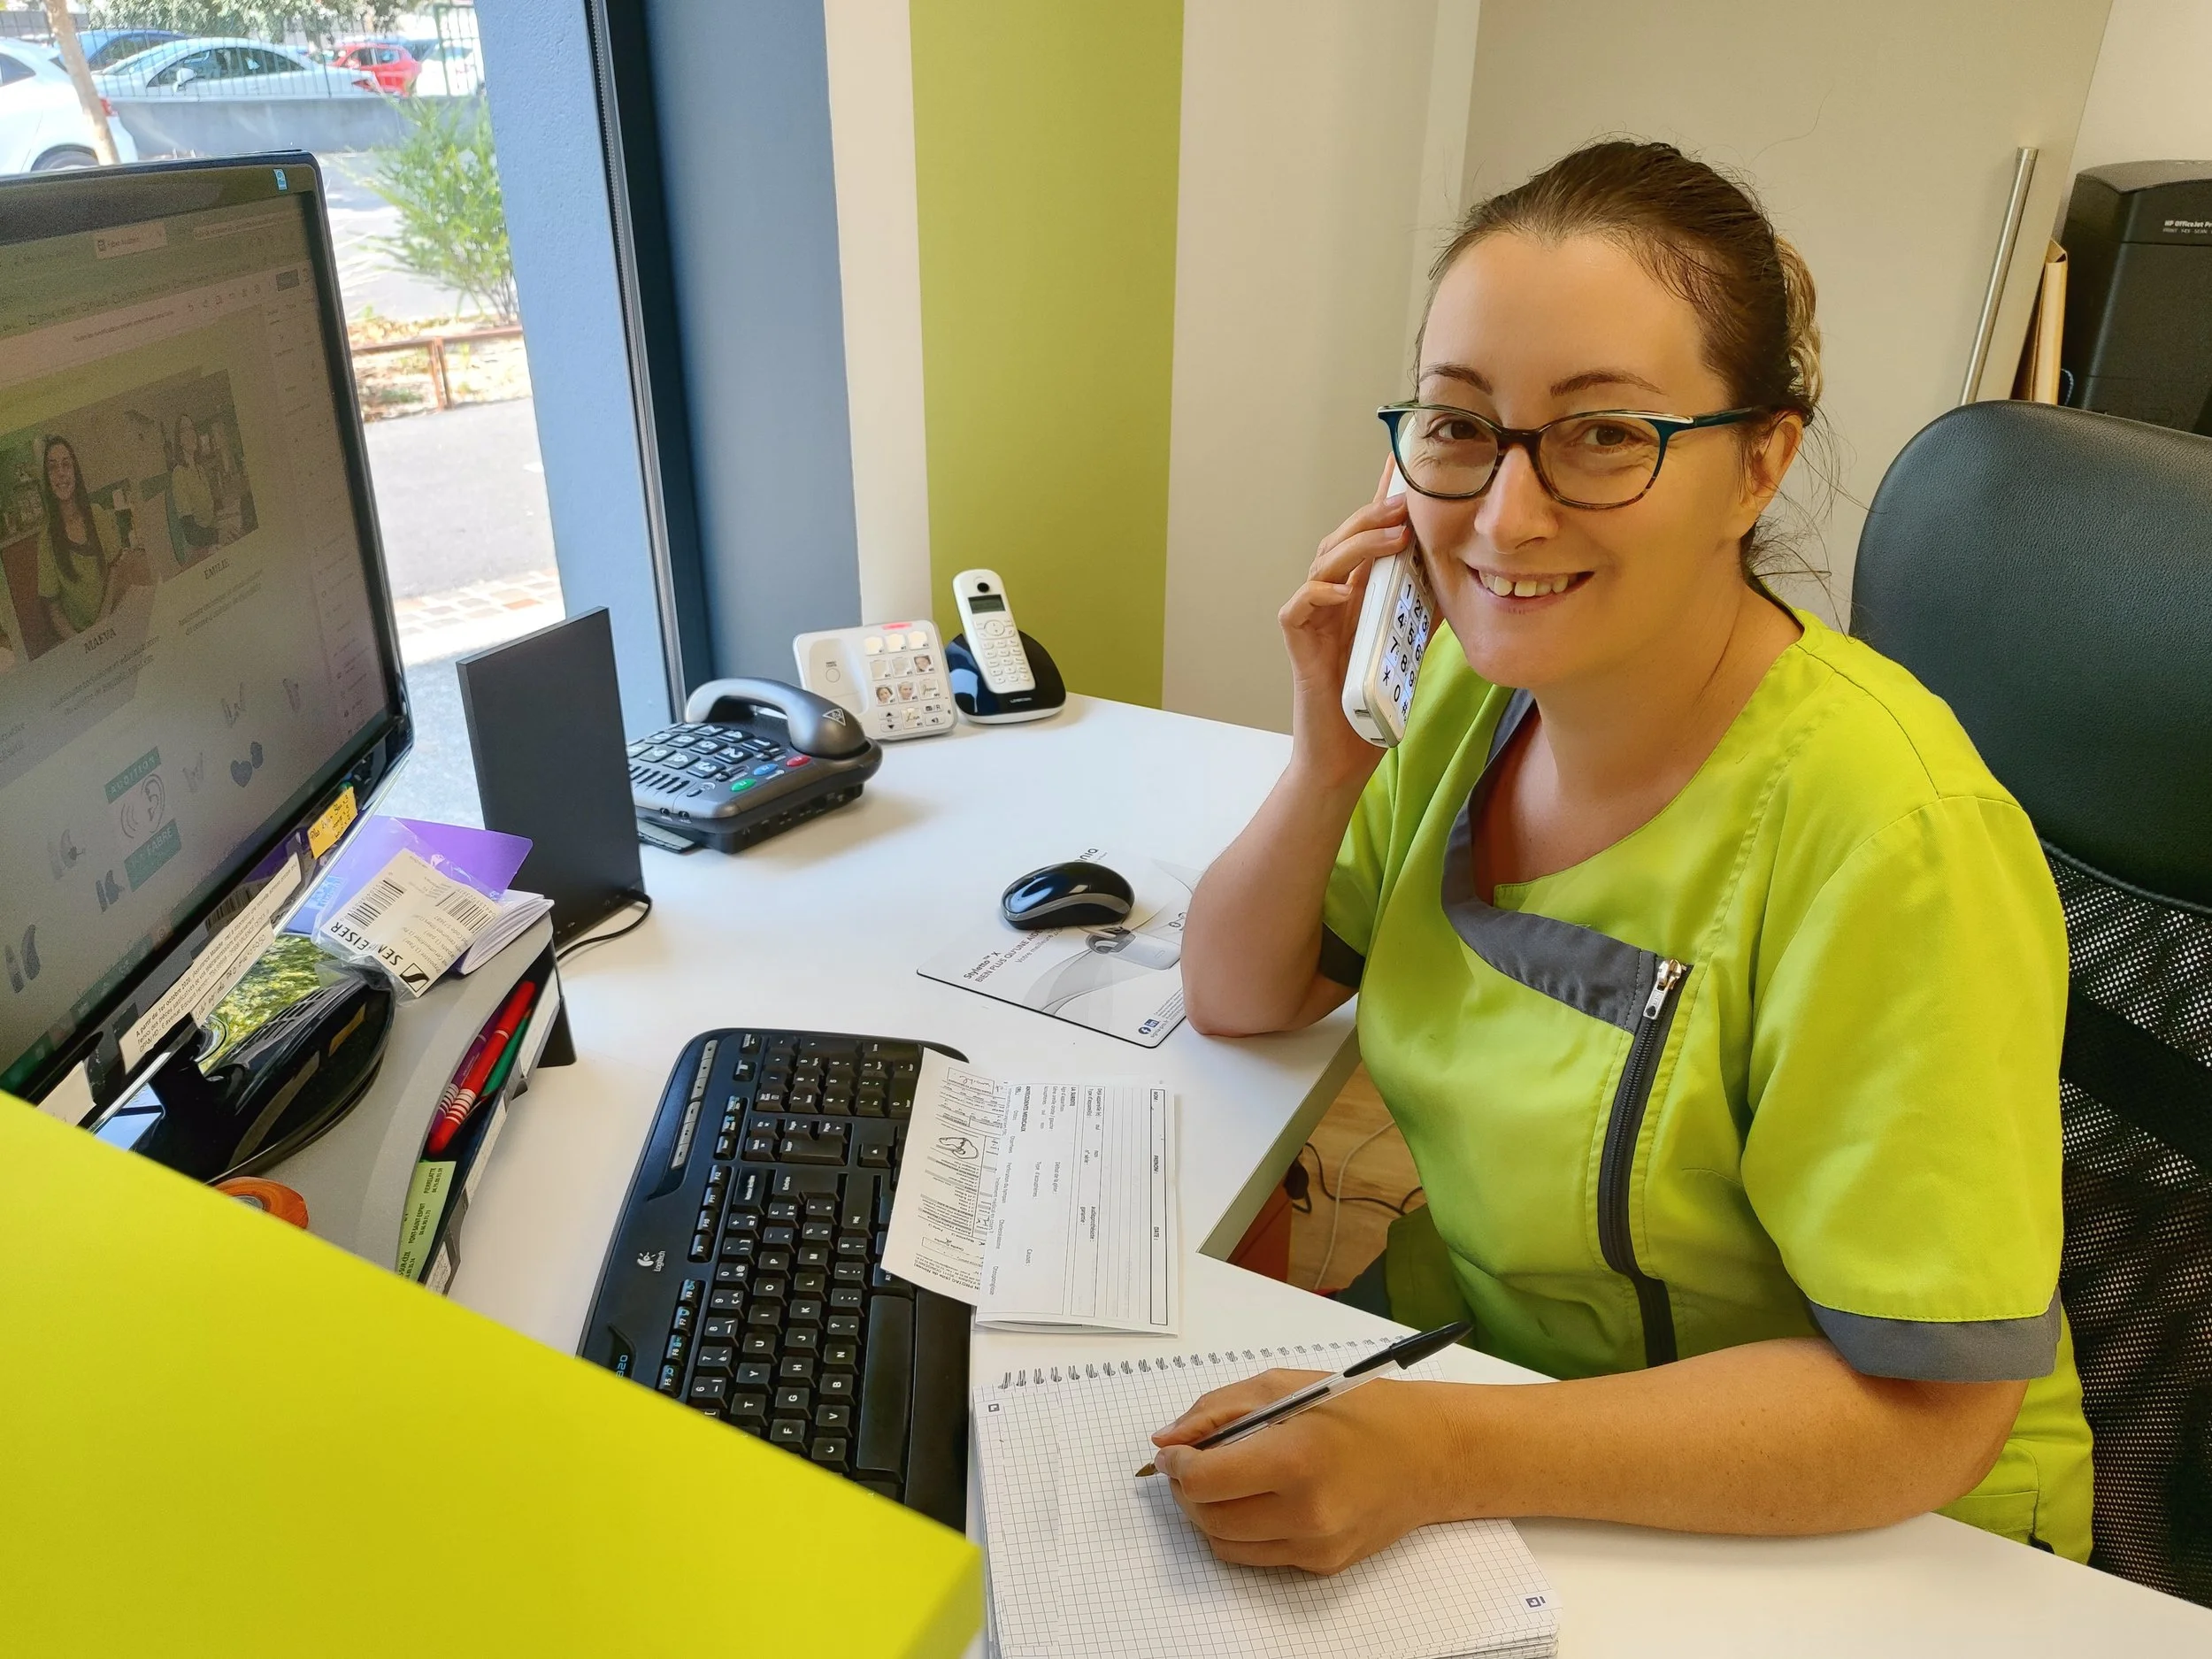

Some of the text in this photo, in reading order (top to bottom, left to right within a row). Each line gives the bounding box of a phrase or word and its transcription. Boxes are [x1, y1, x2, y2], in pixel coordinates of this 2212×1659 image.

[330, 920, 403, 966] SENEISER
[975, 969, 991, 983] BIEN
[988, 957, 1007, 972] PLUS
[653, 1249, 666, 1271] Logitech
[664, 1377, 672, 1386] F5
